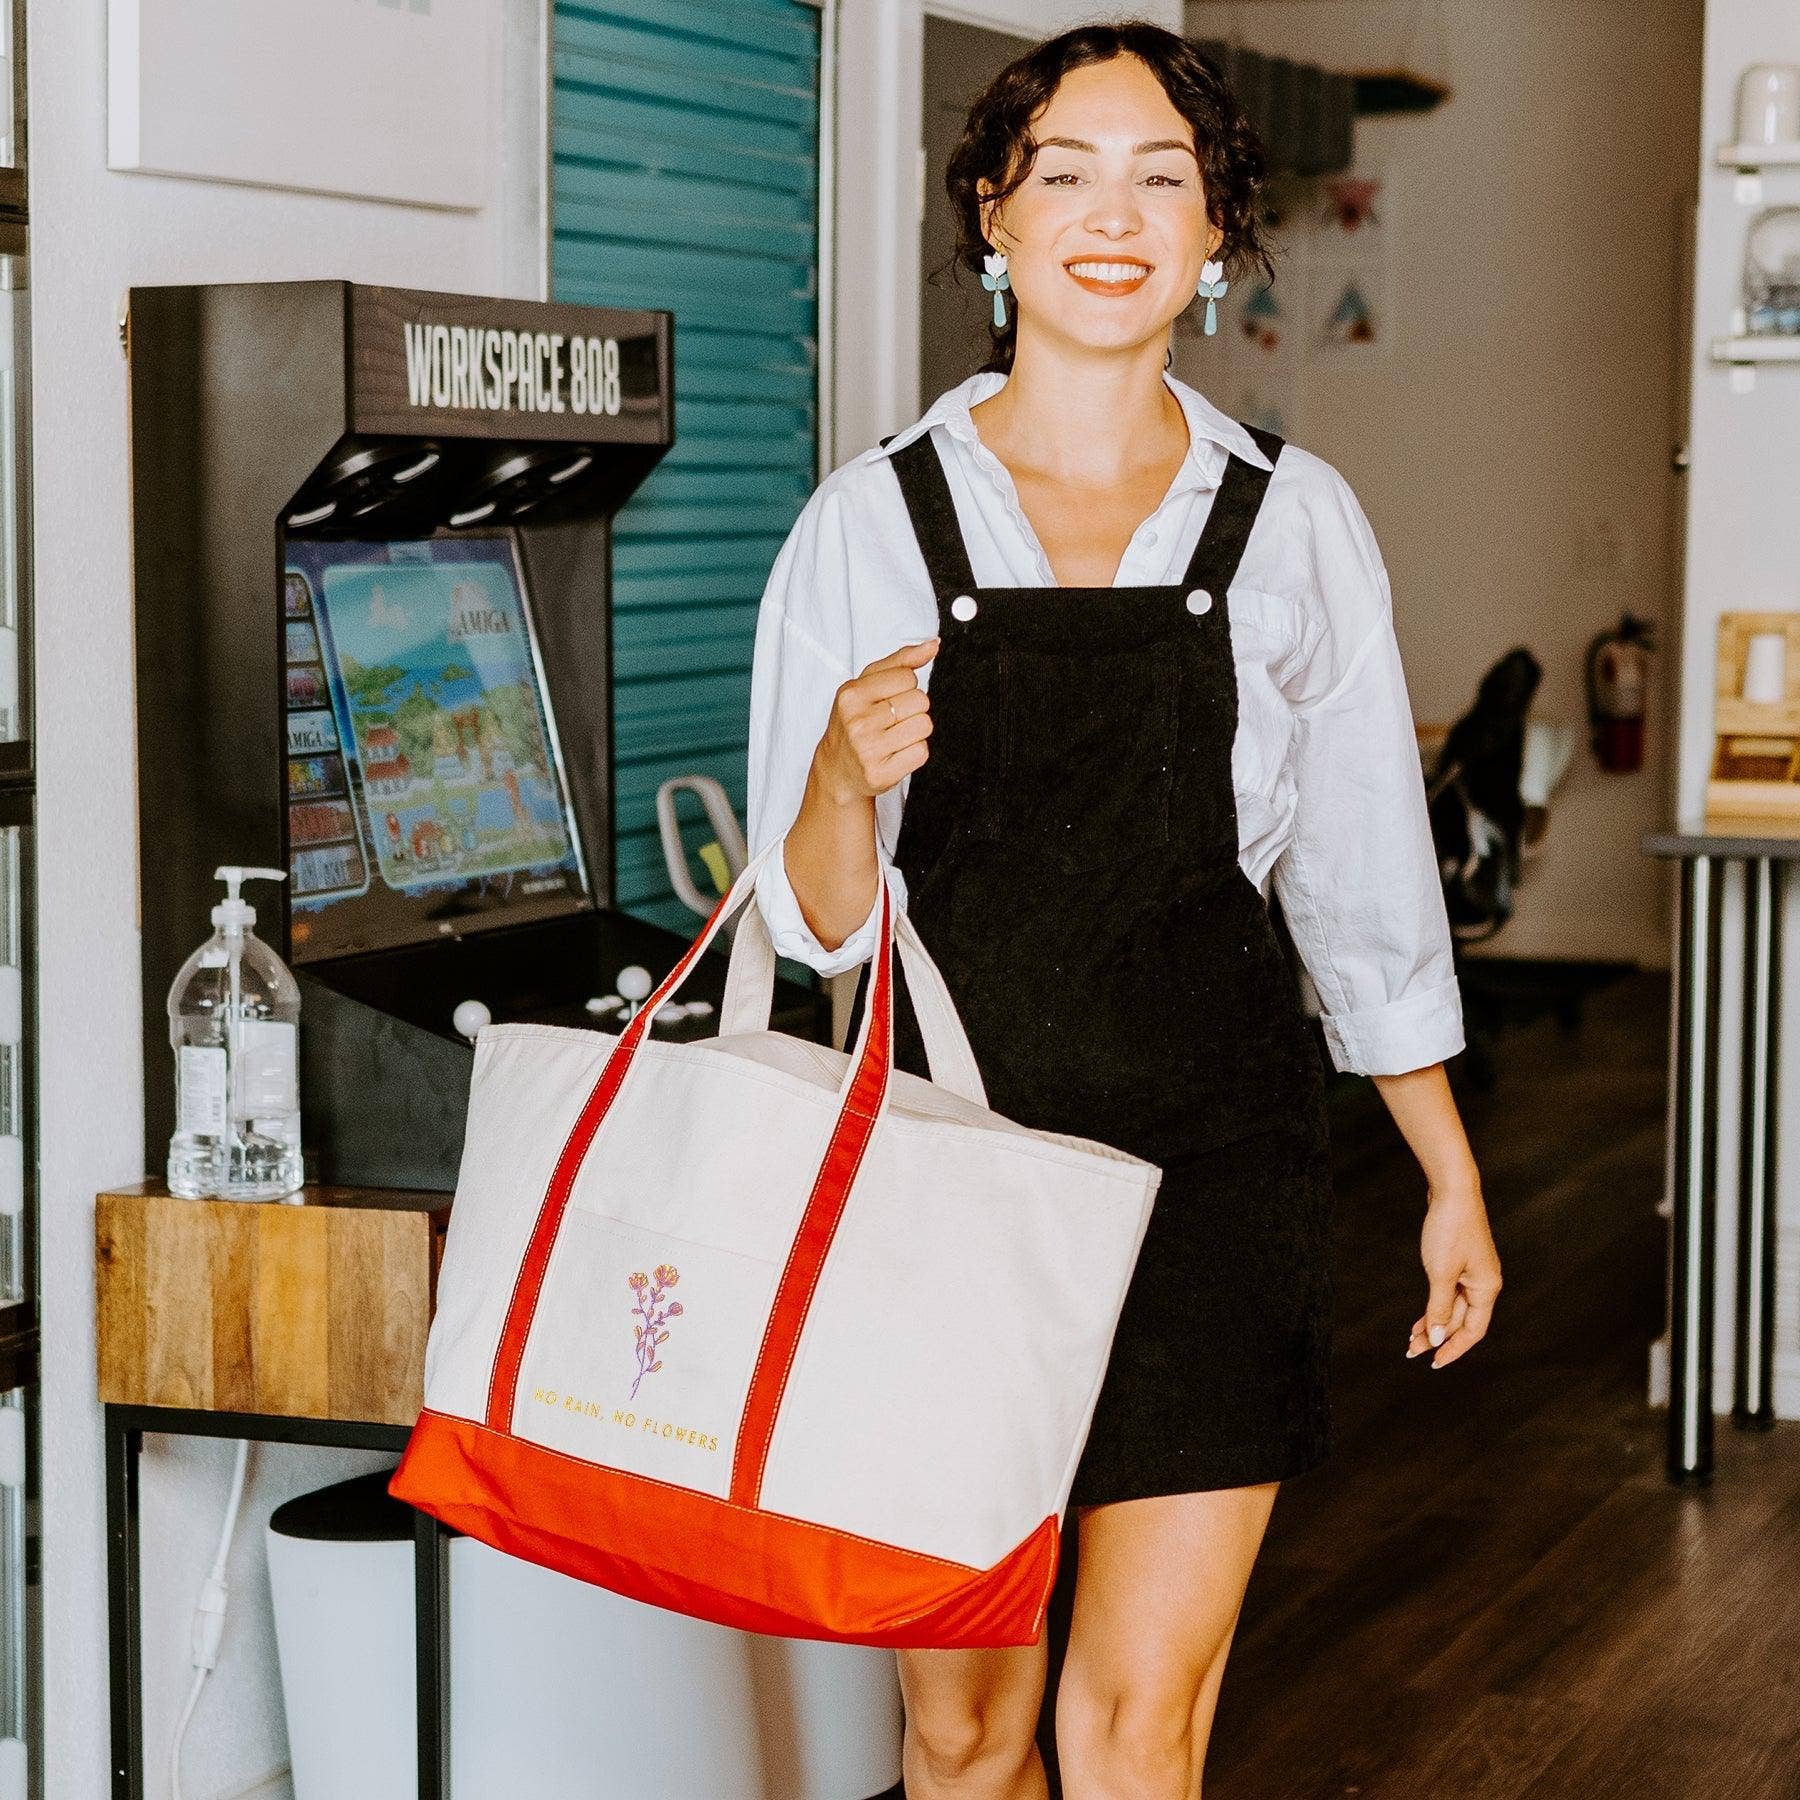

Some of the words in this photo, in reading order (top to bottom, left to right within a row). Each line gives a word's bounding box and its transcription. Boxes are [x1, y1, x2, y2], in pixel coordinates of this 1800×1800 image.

[404, 323, 565, 413] WORKSPACE
[570, 336, 621, 416] 808
[458, 608, 512, 635] AMIGA
[534, 1387, 557, 1406] NO
[563, 1395, 604, 1421] RAIN,
[613, 1409, 636, 1428] NO
[643, 1418, 719, 1452] FLOWERS
